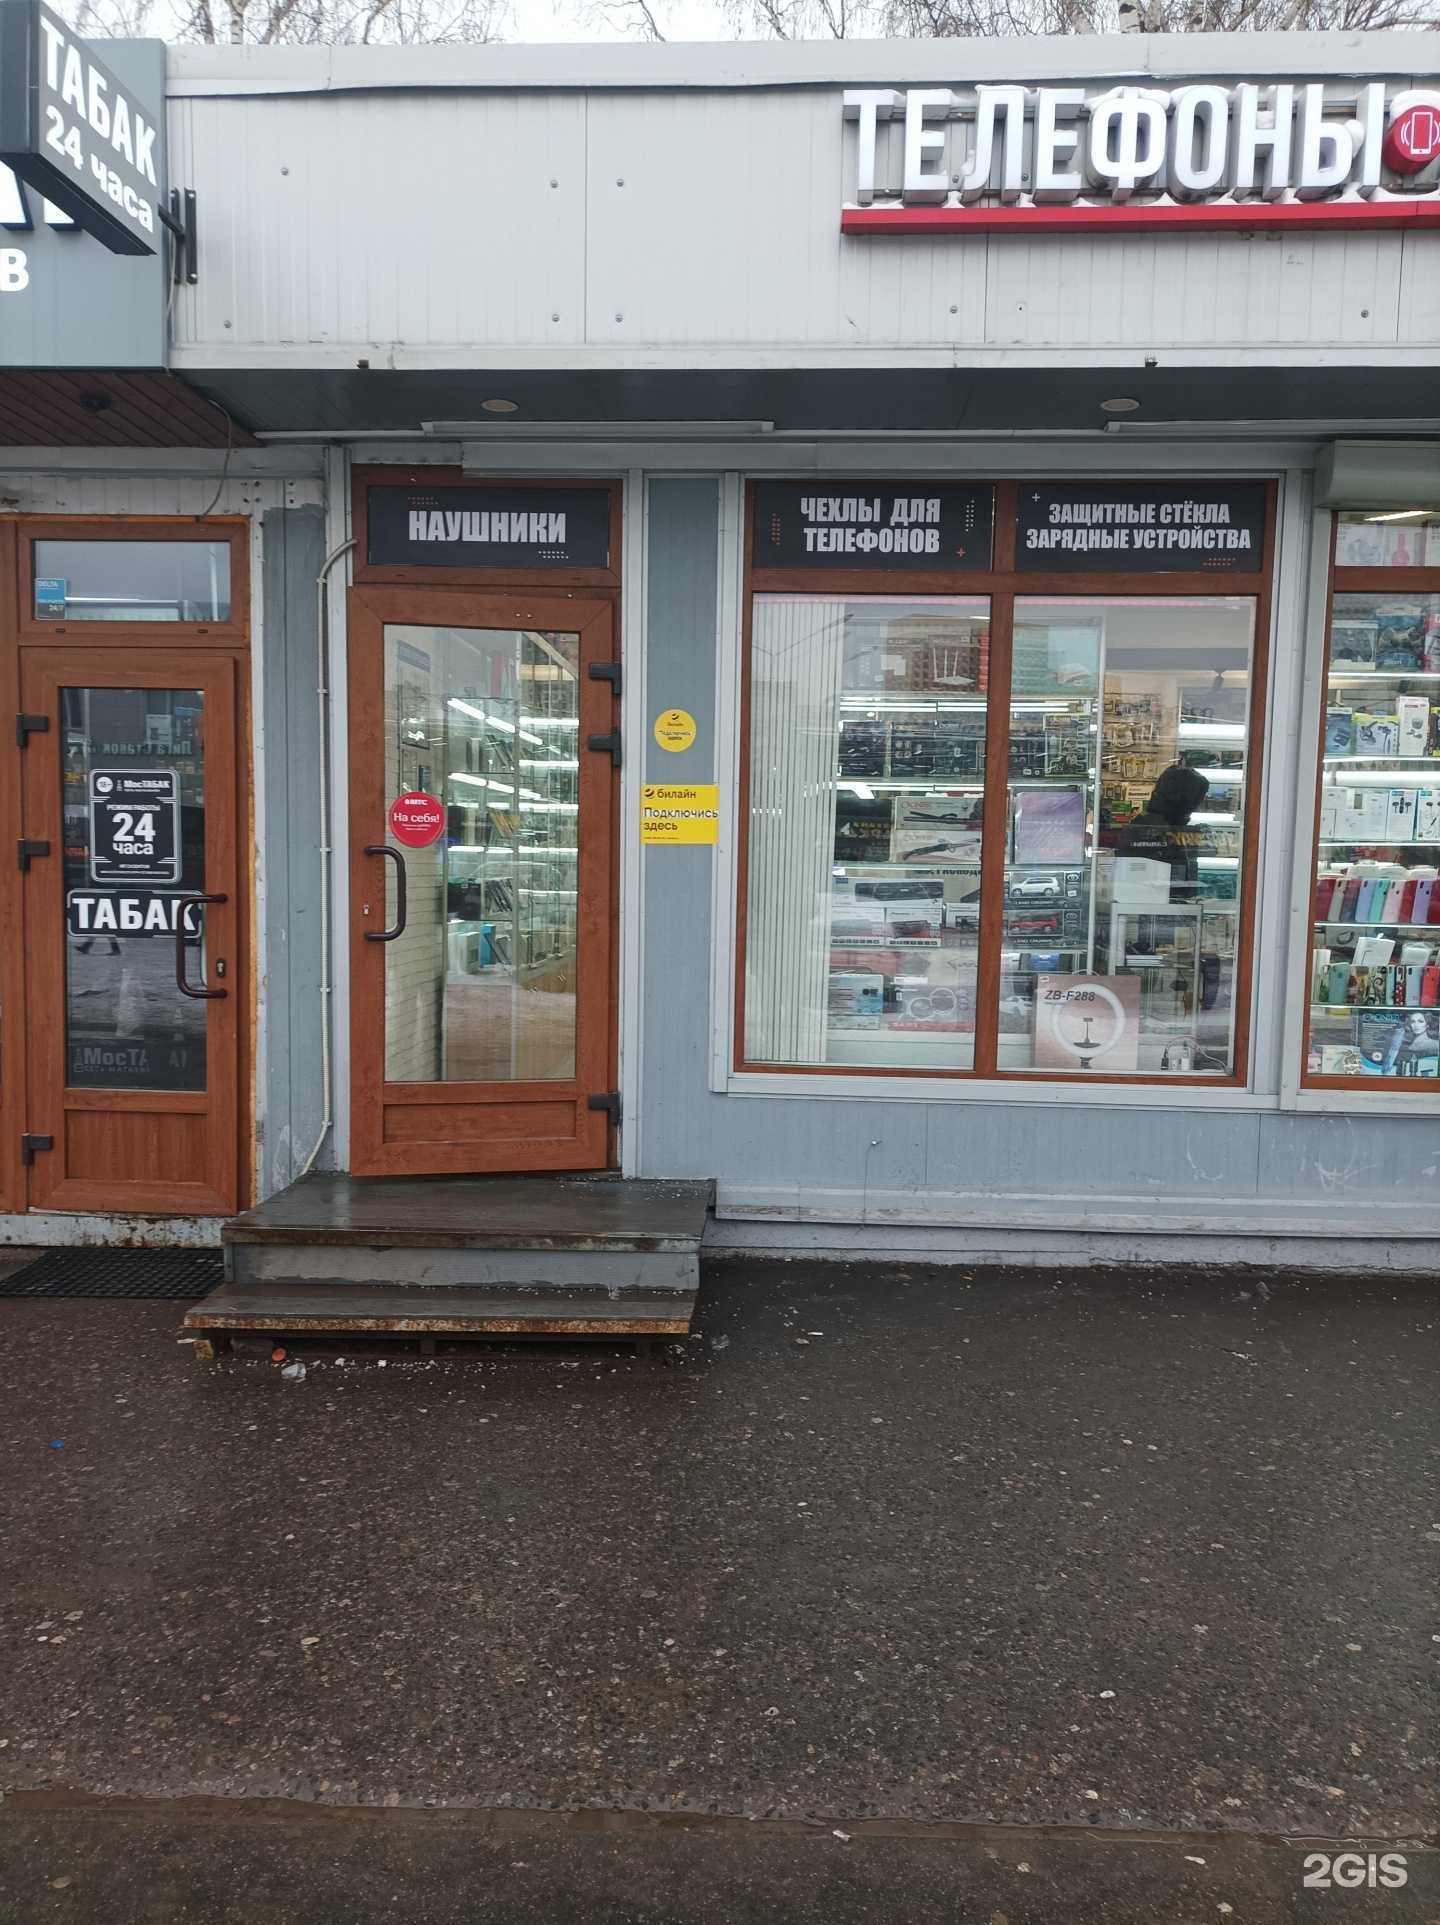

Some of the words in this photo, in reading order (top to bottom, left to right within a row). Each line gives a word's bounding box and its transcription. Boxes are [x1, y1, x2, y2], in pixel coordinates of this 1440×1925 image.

[40, 15, 157, 187] ТАБАК
[842, 82, 1387, 202] ТЕЛЕФОНЫ
[46, 104, 84, 171] 24
[90, 152, 154, 234] часа
[800, 497, 881, 524] ЧЕХЛЫ
[890, 498, 942, 526] ДЛЯ
[1048, 503, 1155, 526] ЗАЩИТНЫЕ
[1159, 500, 1231, 525] СТЁКЛА
[408, 510, 567, 544] НАУШНИКИ
[1026, 528, 1129, 552] ЗАРЯДНЫЕ
[1133, 525, 1252, 550] УСТРОЙСТВА
[803, 528, 940, 554] ТЕЛЕФОНОВ
[656, 788, 697, 800] билайн
[393, 812, 408, 822] На
[411, 813, 440, 824] себя!
[643, 807, 720, 819] Подключись
[112, 812, 156, 842] 24
[643, 822, 678, 831] здесь
[112, 842, 154, 856] часа
[72, 898, 197, 931] ТАБАК
[1044, 989, 1096, 1001] ZB-F288
